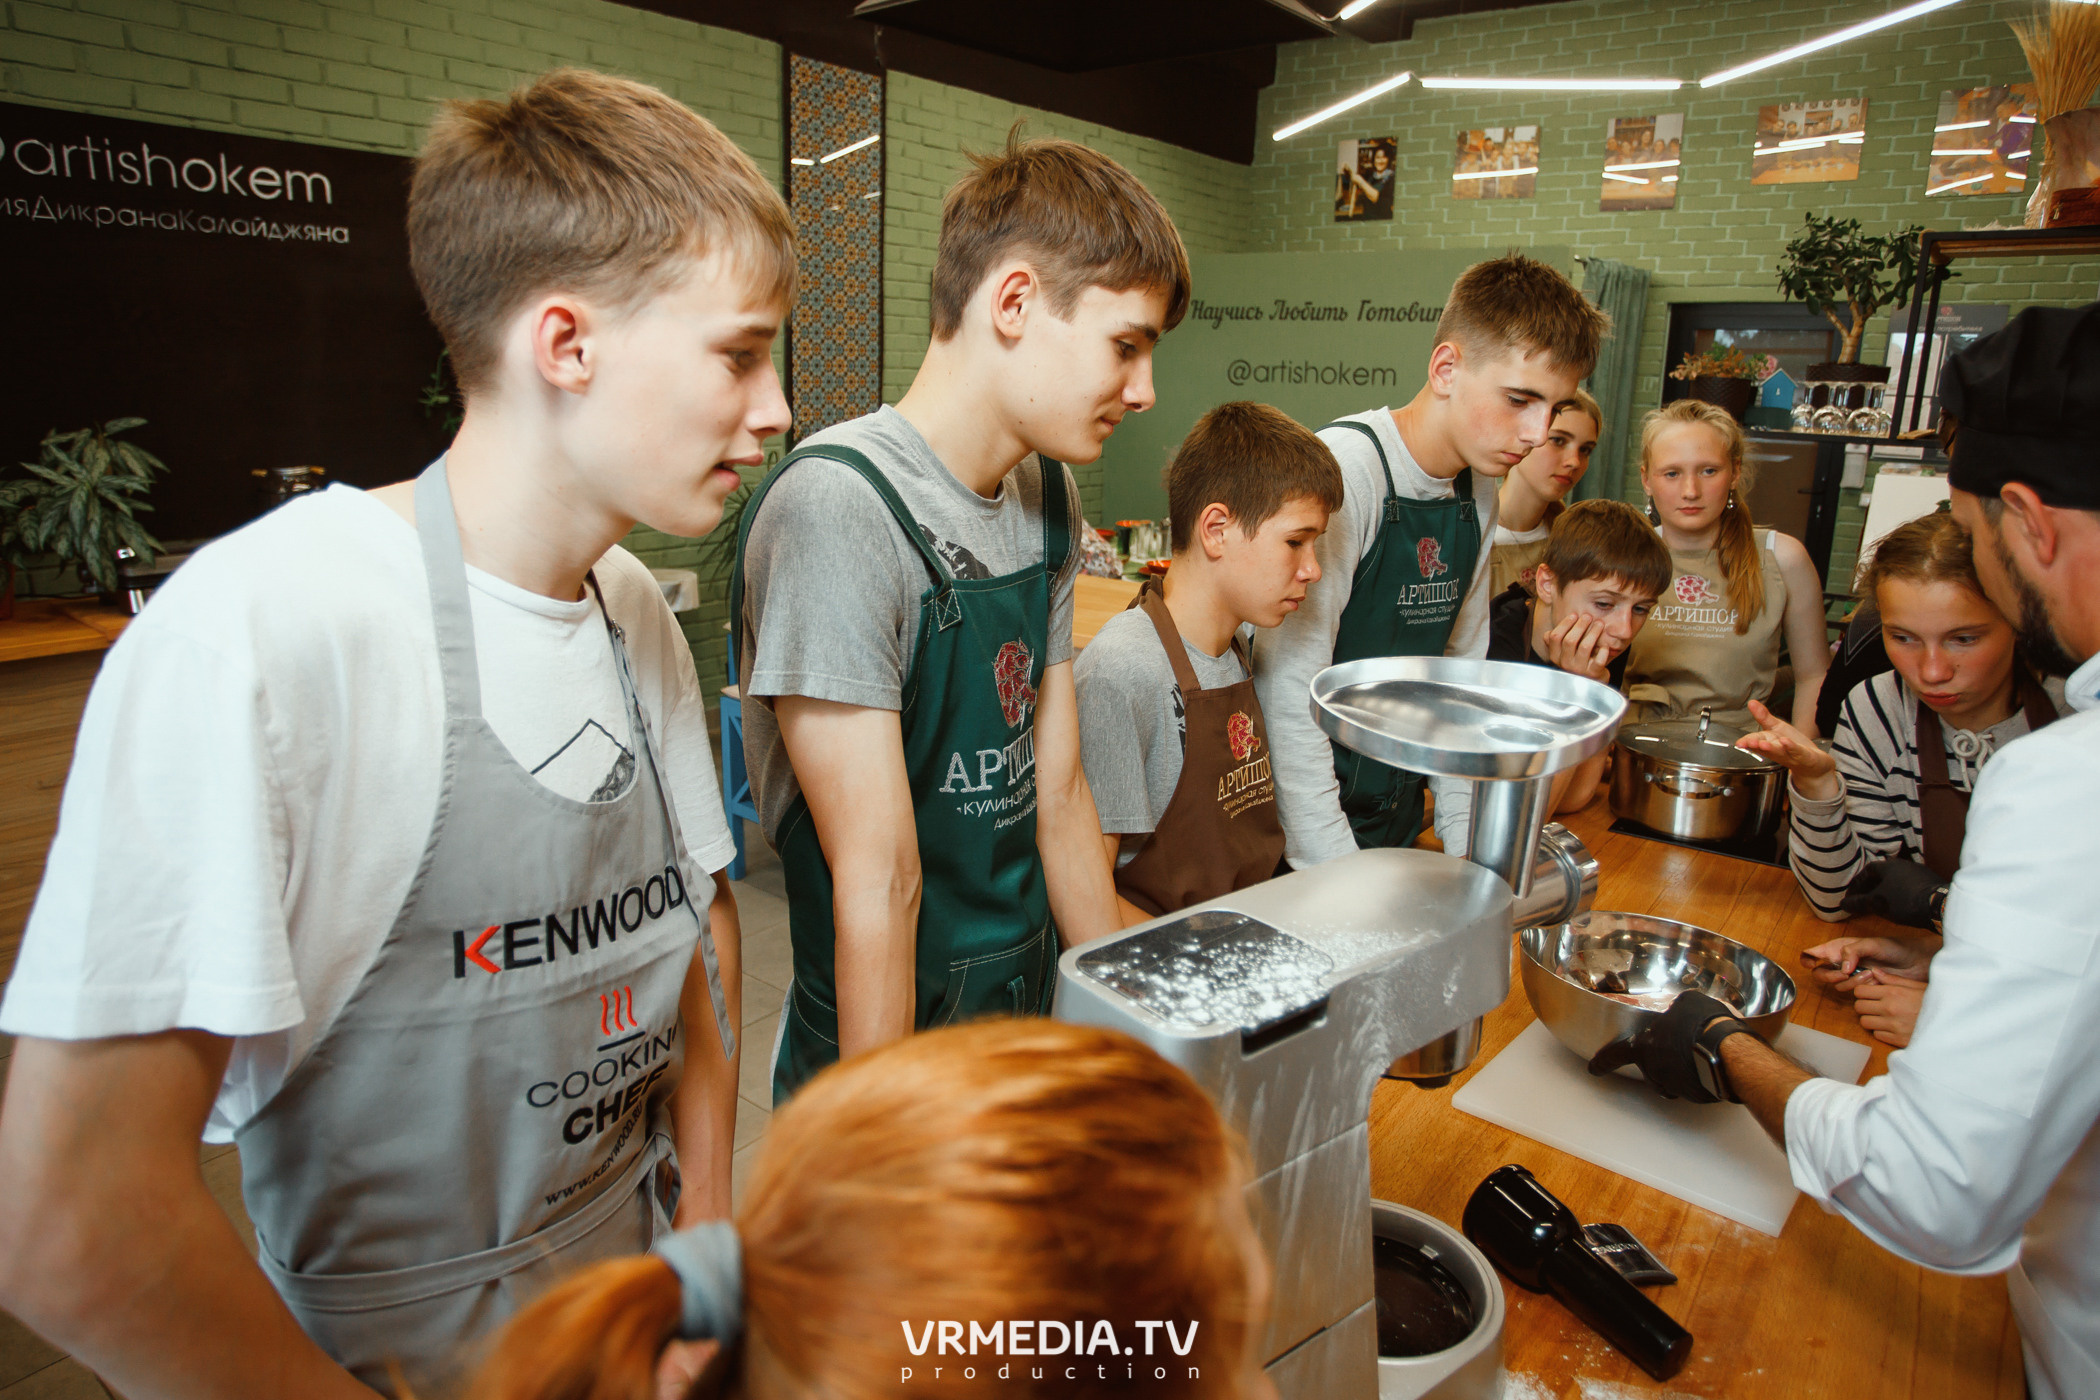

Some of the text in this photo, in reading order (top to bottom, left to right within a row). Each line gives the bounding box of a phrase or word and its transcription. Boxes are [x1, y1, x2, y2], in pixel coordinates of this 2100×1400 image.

[0, 134, 333, 206] artishokem
[1191, 299, 1263, 329] Научись
[1269, 299, 1348, 322] Любить
[1227, 359, 1397, 386] @artishokem
[453, 865, 685, 979] KENWOOD
[527, 1023, 677, 1108] COOKIN
[562, 1060, 671, 1145] CHEF
